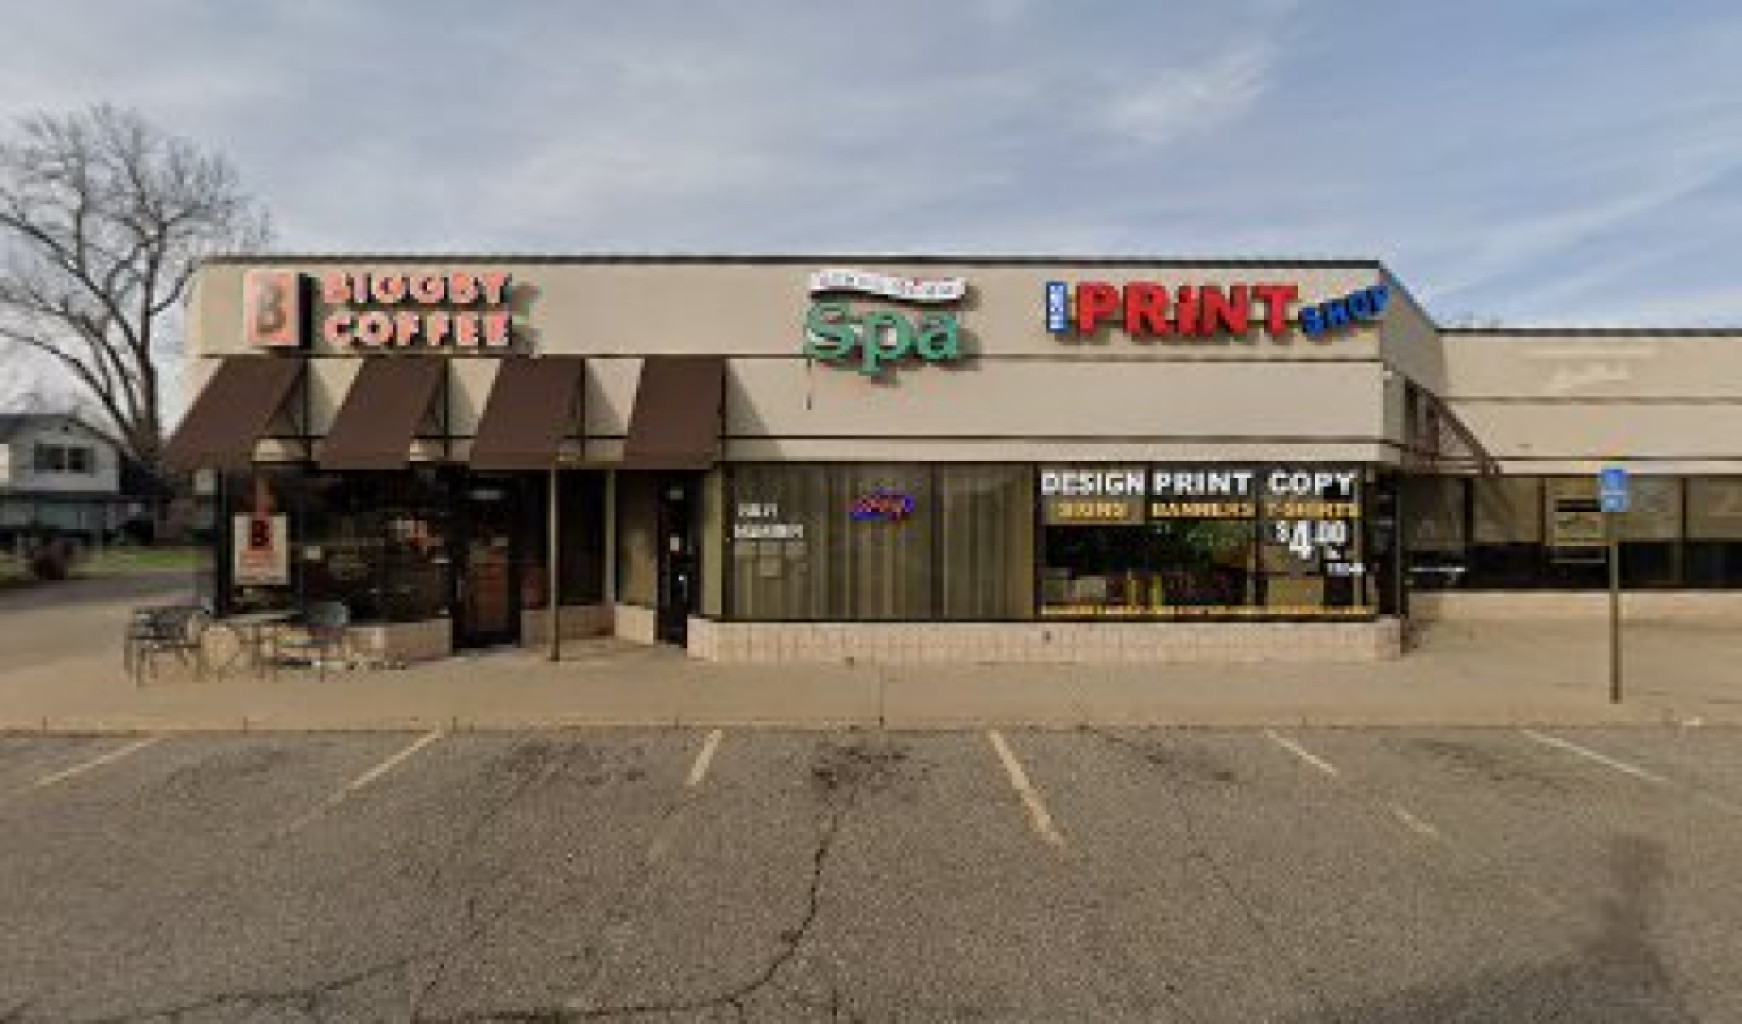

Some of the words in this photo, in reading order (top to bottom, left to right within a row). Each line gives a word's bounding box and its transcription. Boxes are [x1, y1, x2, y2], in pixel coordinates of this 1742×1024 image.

[323, 310, 511, 347] COFFEE
[1299, 284, 1390, 337] SHOP
[1040, 470, 1146, 496] DESIGN
[1152, 472, 1254, 496] PRINT
[1270, 472, 1356, 496] COPY
